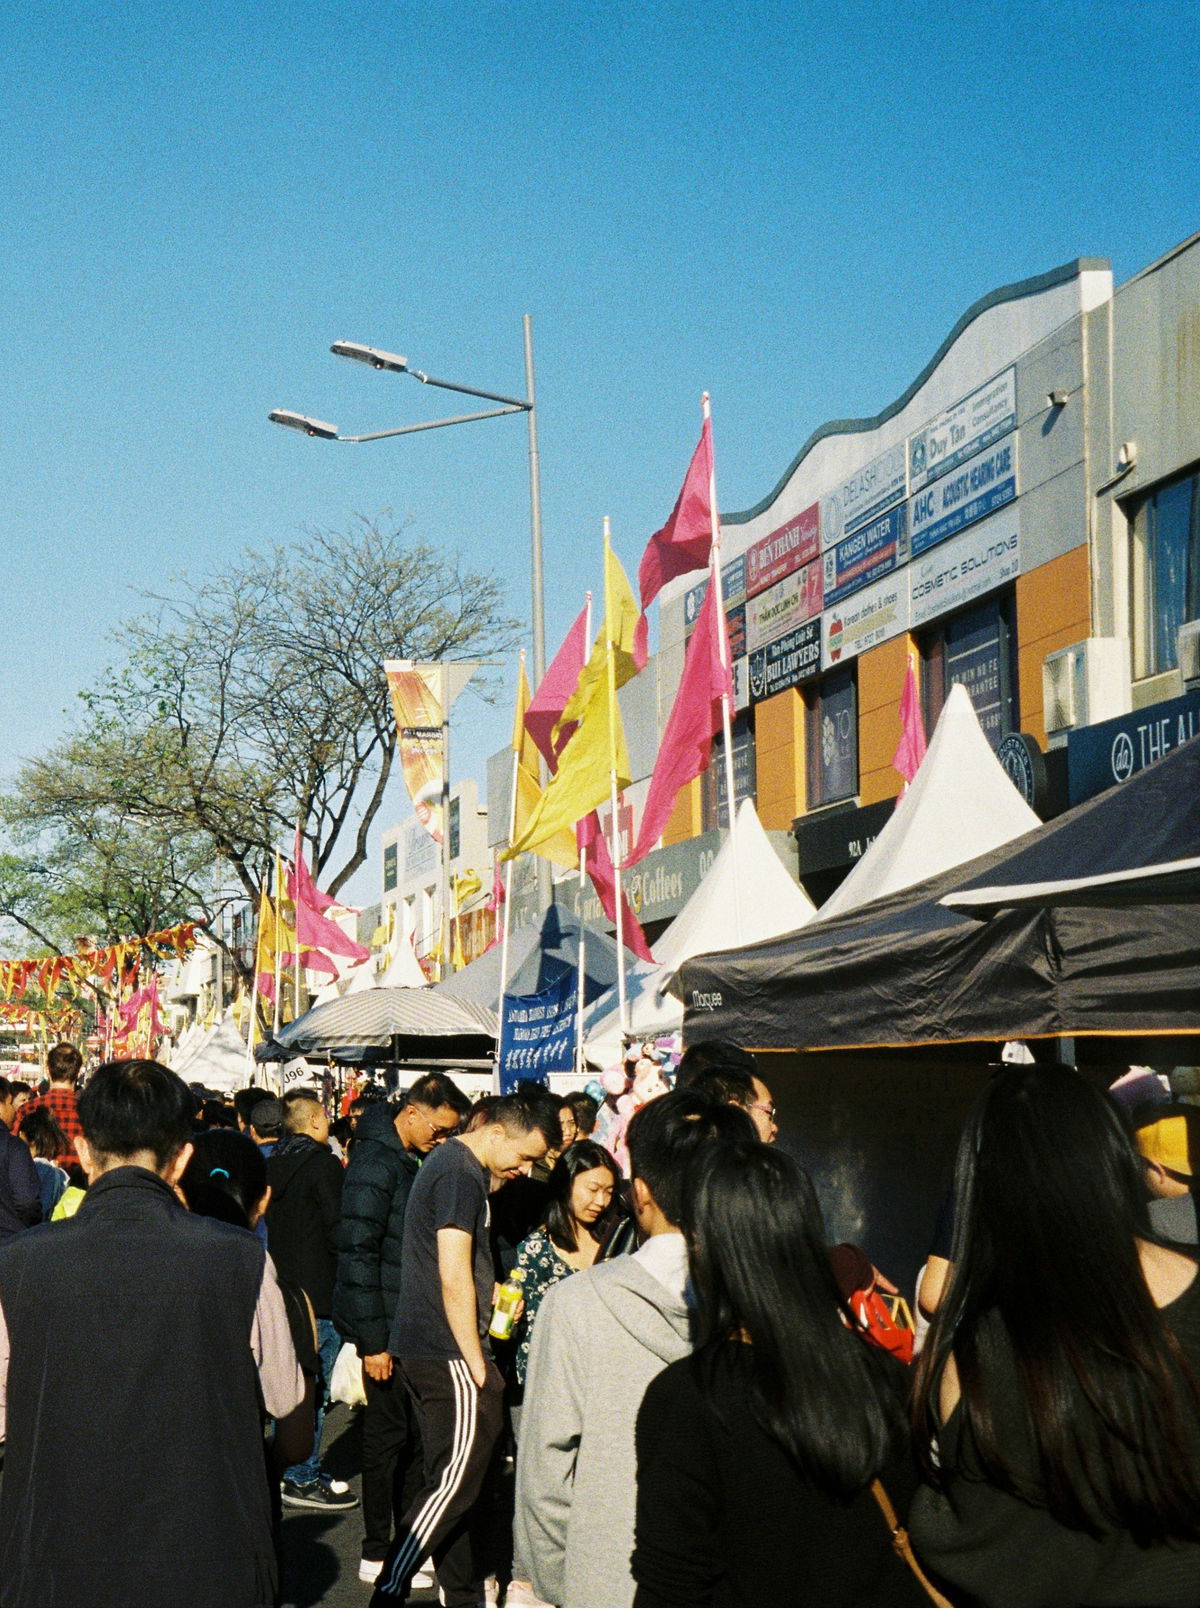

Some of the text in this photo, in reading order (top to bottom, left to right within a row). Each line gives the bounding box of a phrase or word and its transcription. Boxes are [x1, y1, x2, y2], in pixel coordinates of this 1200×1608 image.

[913, 490, 934, 527] AHC
[867, 518, 891, 547] WATER
[912, 566, 958, 600] COSMETIC
[961, 534, 1017, 575] SOLUTIONS
[782, 640, 820, 676] LAWYERS
[643, 866, 683, 906] Coffees
[284, 1067, 304, 1084] J96
